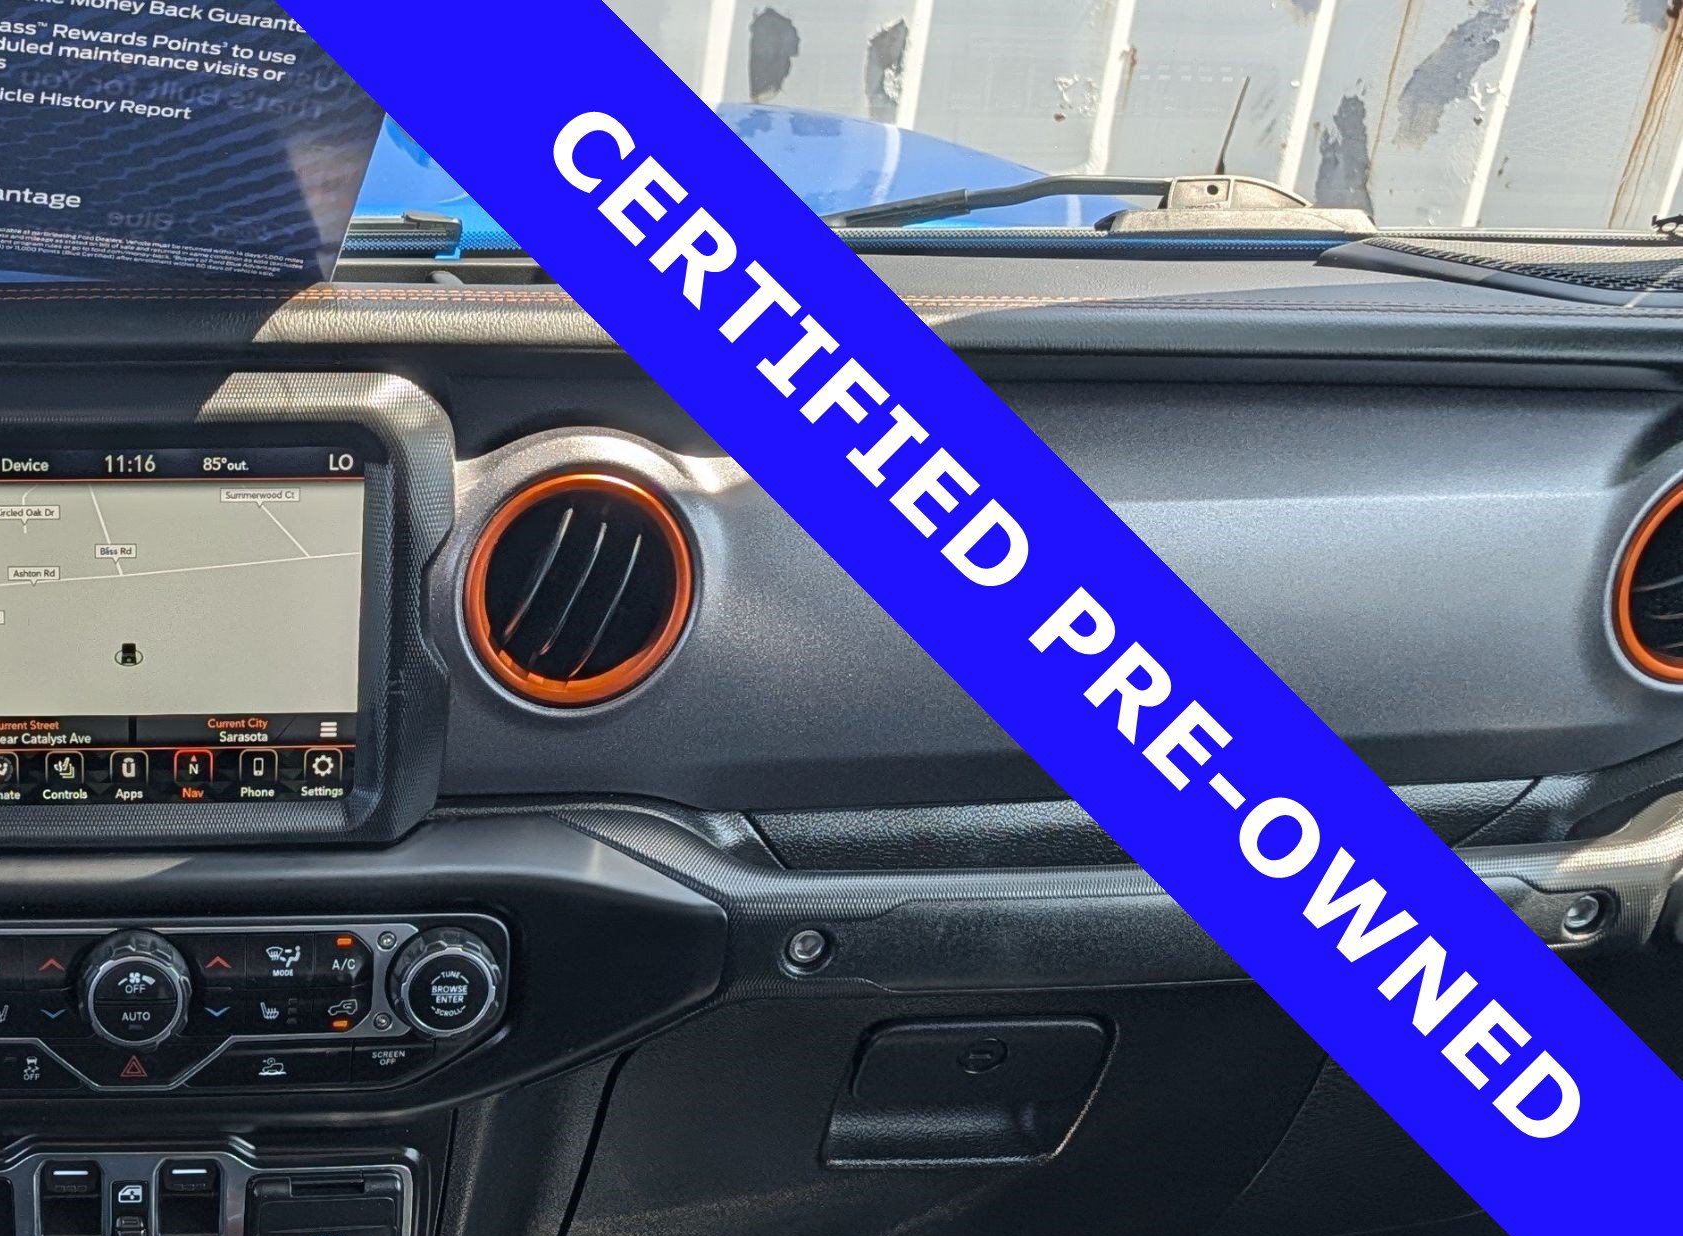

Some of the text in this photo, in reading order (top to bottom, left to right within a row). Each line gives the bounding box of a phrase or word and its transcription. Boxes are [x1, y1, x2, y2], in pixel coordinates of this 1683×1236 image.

[148, 0, 203, 20] Back
[207, 8, 307, 34] Guarante
[52, 24, 148, 48] Rewards
[231, 44, 254, 60] to
[258, 51, 297, 65] use
[57, 46, 200, 72] maintenance
[202, 61, 259, 80] visits
[262, 67, 286, 82] or
[39, 91, 117, 114] History
[118, 99, 193, 121] Report
[1, 457, 49, 473] Device
[105, 454, 156, 474] 11:16
[329, 454, 354, 472] LO
[225, 490, 295, 500] Summerwood Ct
[26, 508, 42, 517] Oak
[44, 508, 55, 517] Dr
[120, 547, 132, 556] Rd
[13, 569, 56, 579] Ashton Rd
[29, 720, 60, 730] Street
[207, 718, 269, 731] Current City
[21, 733, 67, 746] Catalyst
[69, 733, 92, 744] Ave
[219, 731, 269, 743] Sarasota
[42, 789, 88, 800] Controls
[115, 789, 143, 801] Apps
[182, 787, 204, 798] Nav
[240, 786, 275, 797] Phone
[301, 786, 344, 799] Settings
[332, 958, 356, 971] A/C
[272, 969, 294, 977] MODE
[440, 971, 462, 980] TUNE
[124, 984, 146, 994] OFF
[431, 985, 468, 994] BROWSE
[435, 995, 464, 1004] ENTER
[121, 1011, 151, 1022] AUTO
[433, 1006, 464, 1017] SCROLL
[371, 1050, 405, 1059] SCREEN
[379, 1058, 397, 1066] OFF
[23, 1072, 40, 1081] OFF
